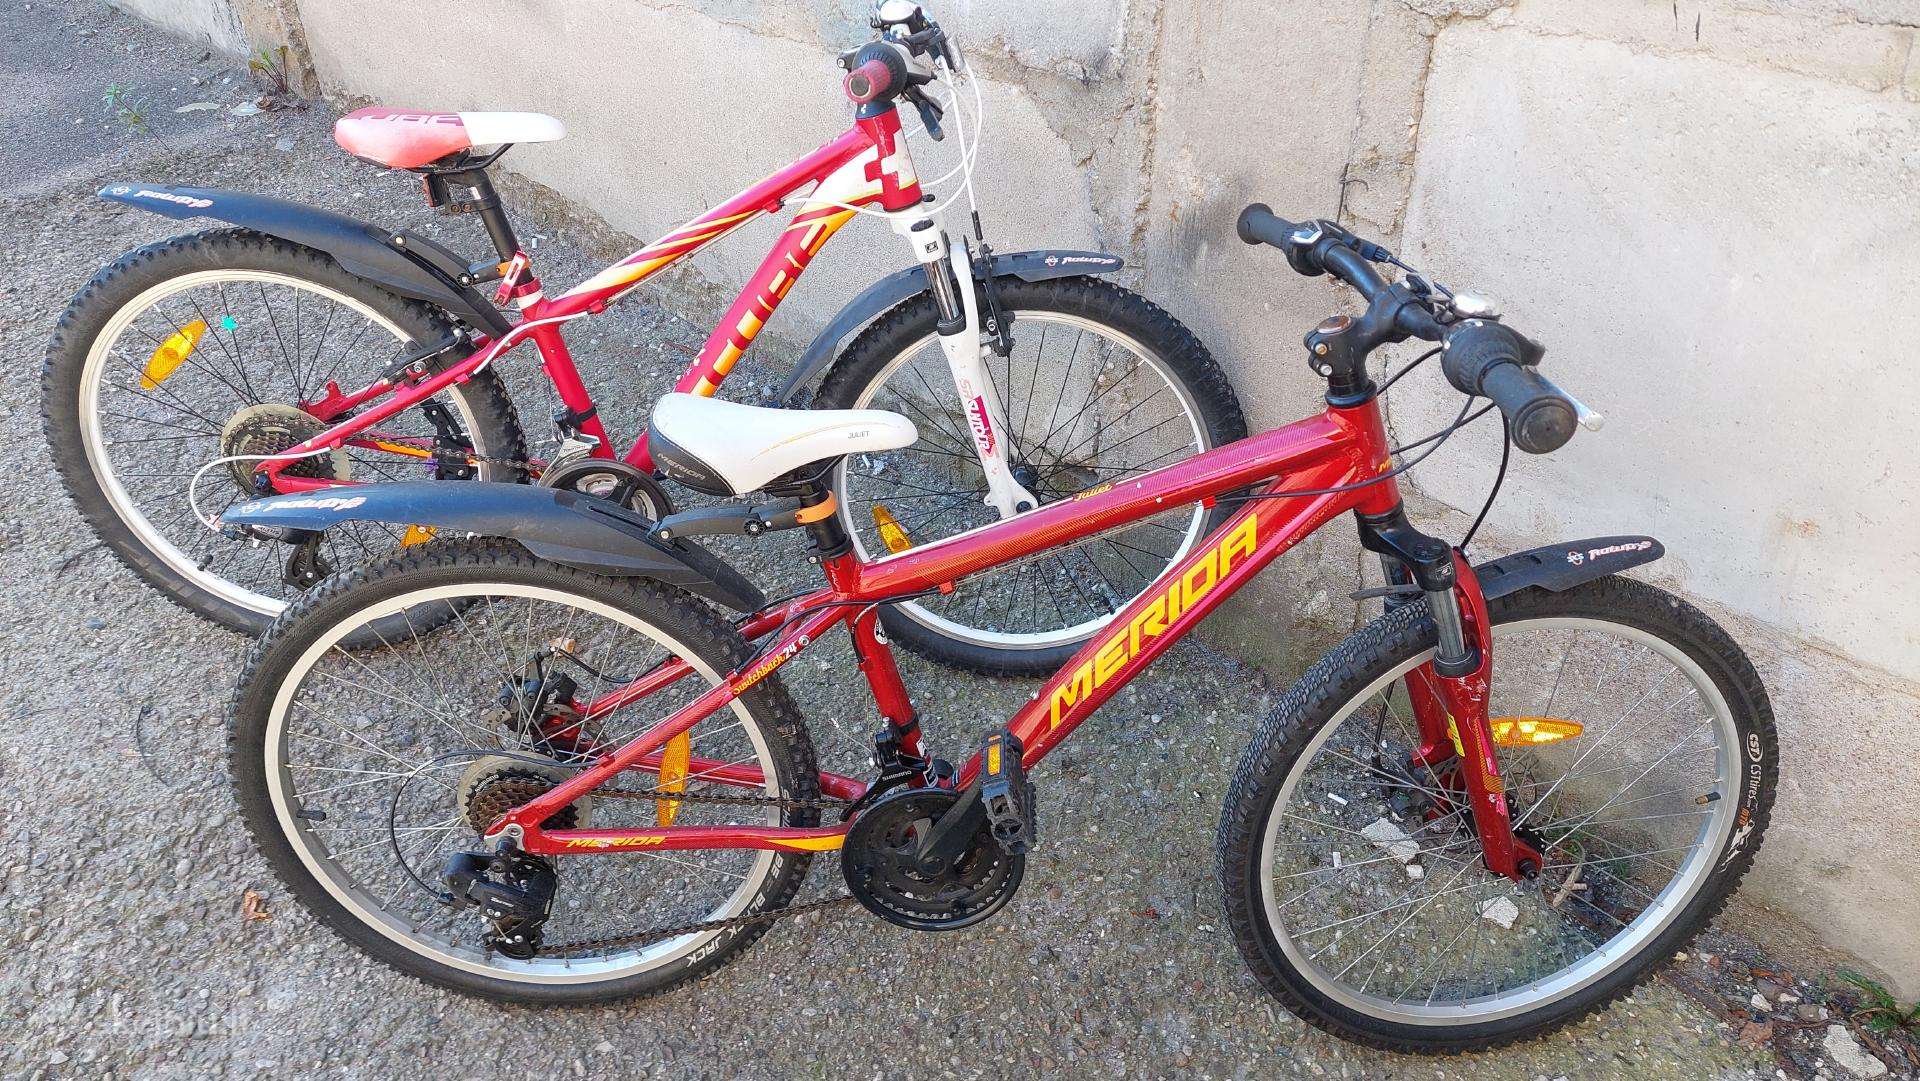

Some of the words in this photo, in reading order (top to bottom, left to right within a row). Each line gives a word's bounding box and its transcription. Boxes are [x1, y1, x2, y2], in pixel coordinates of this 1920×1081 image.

[1050, 512, 1258, 731] MERIDA
[782, 641, 798, 660] 24
[686, 936, 722, 968] JACK
